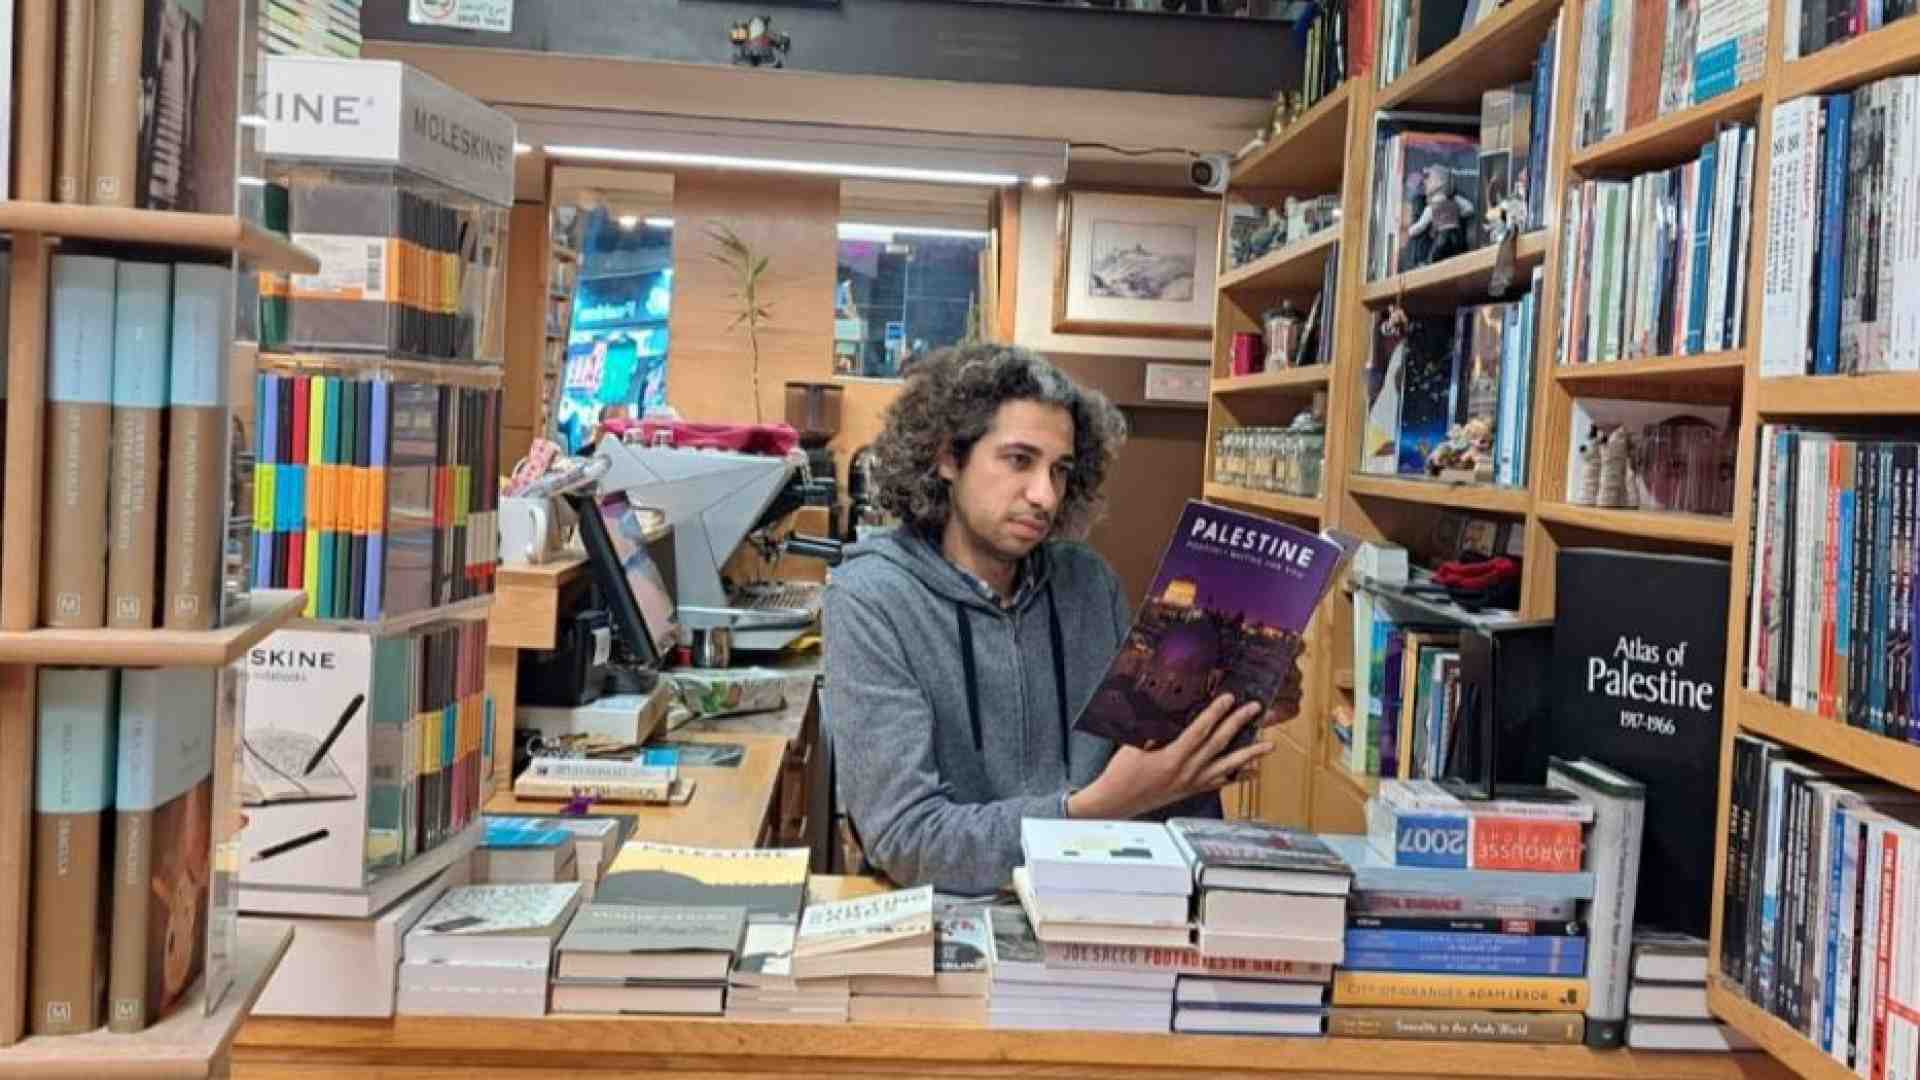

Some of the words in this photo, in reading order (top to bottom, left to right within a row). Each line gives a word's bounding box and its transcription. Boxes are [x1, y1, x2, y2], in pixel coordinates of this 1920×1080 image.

[414, 109, 505, 169] MOLESKINE
[1191, 517, 1315, 568] PALESTINE
[251, 649, 335, 669] SKINE
[1613, 635, 1660, 664] Atlas
[1666, 642, 1688, 667] of
[1588, 656, 1713, 711] Palestine
[1620, 709, 1677, 735] 1917-1966
[1399, 828, 1465, 855] 2007
[1478, 841, 1577, 863] LAROUSSE
[1063, 944, 1086, 961] JOE
[1094, 945, 1137, 963] SACCO
